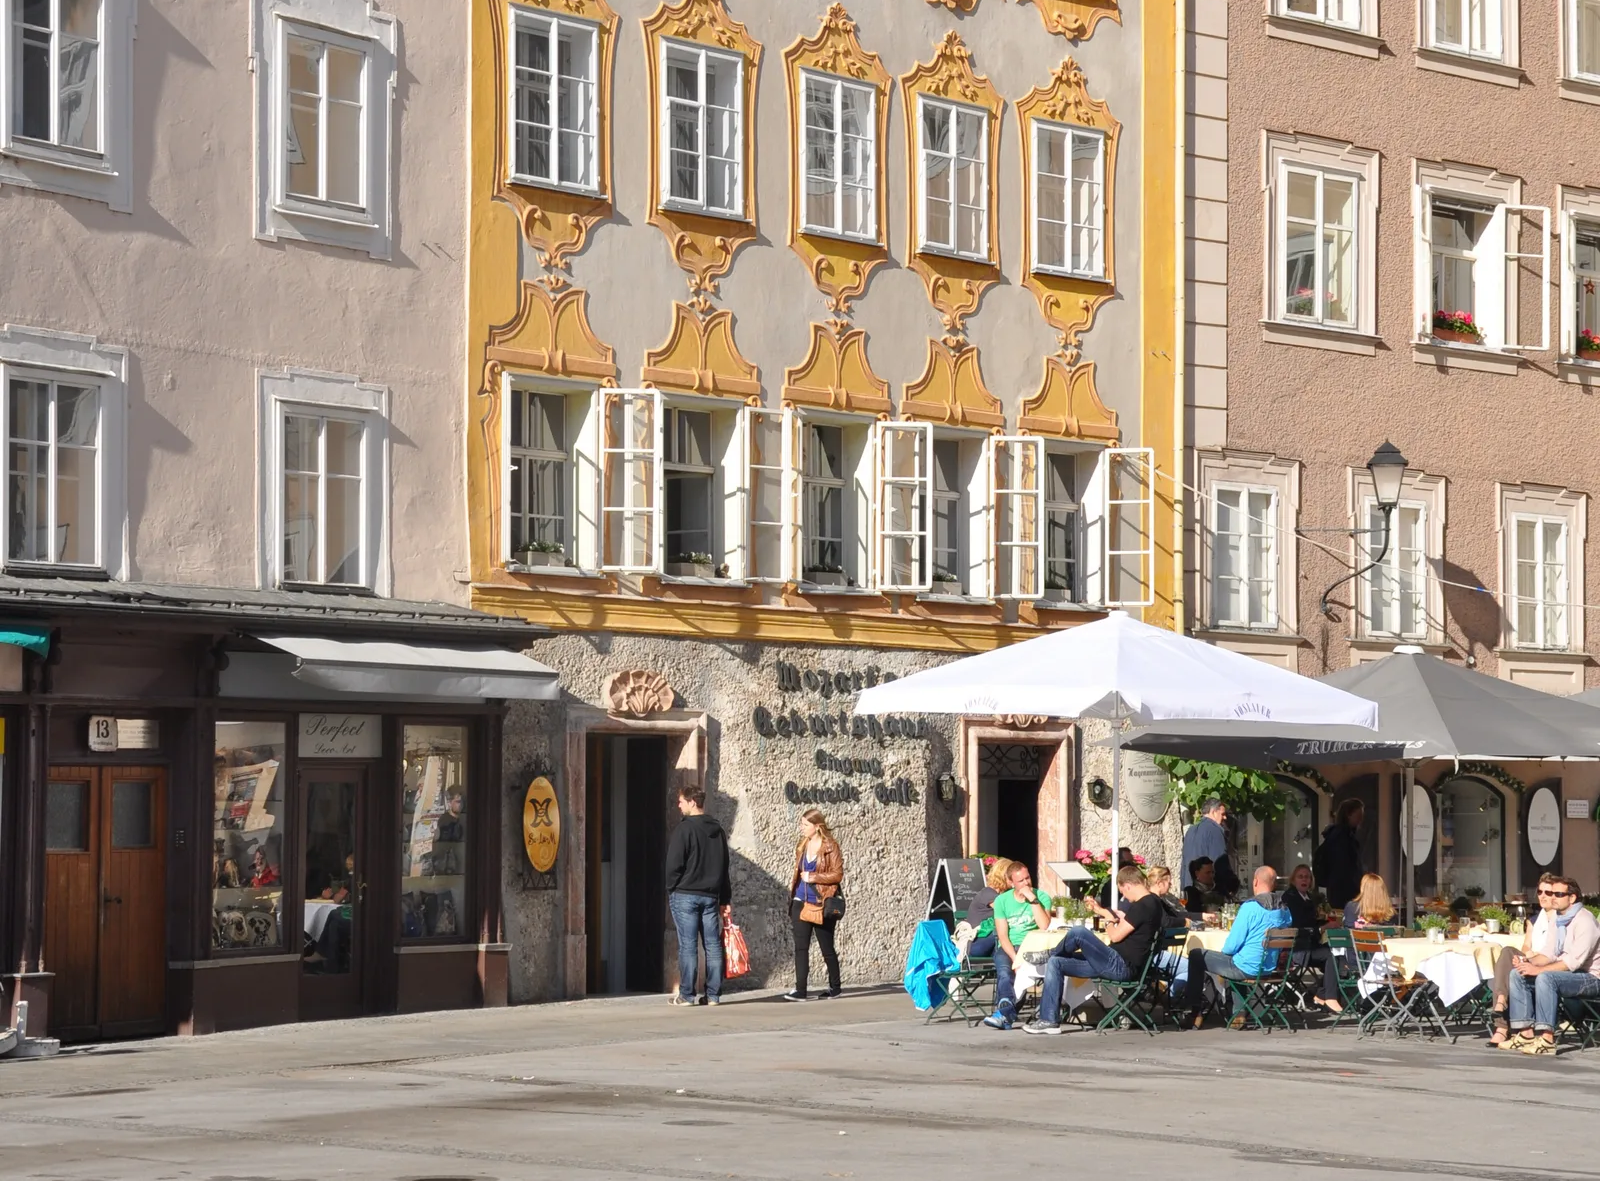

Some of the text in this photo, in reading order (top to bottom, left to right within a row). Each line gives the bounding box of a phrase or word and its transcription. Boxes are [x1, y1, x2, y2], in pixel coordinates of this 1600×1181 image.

[96, 719, 110, 738] 13
[306, 714, 366, 743] Perfect
[753, 706, 927, 741] Geburtshaus
[816, 749, 881, 776] Eingang
[785, 780, 859, 804] Getreide
